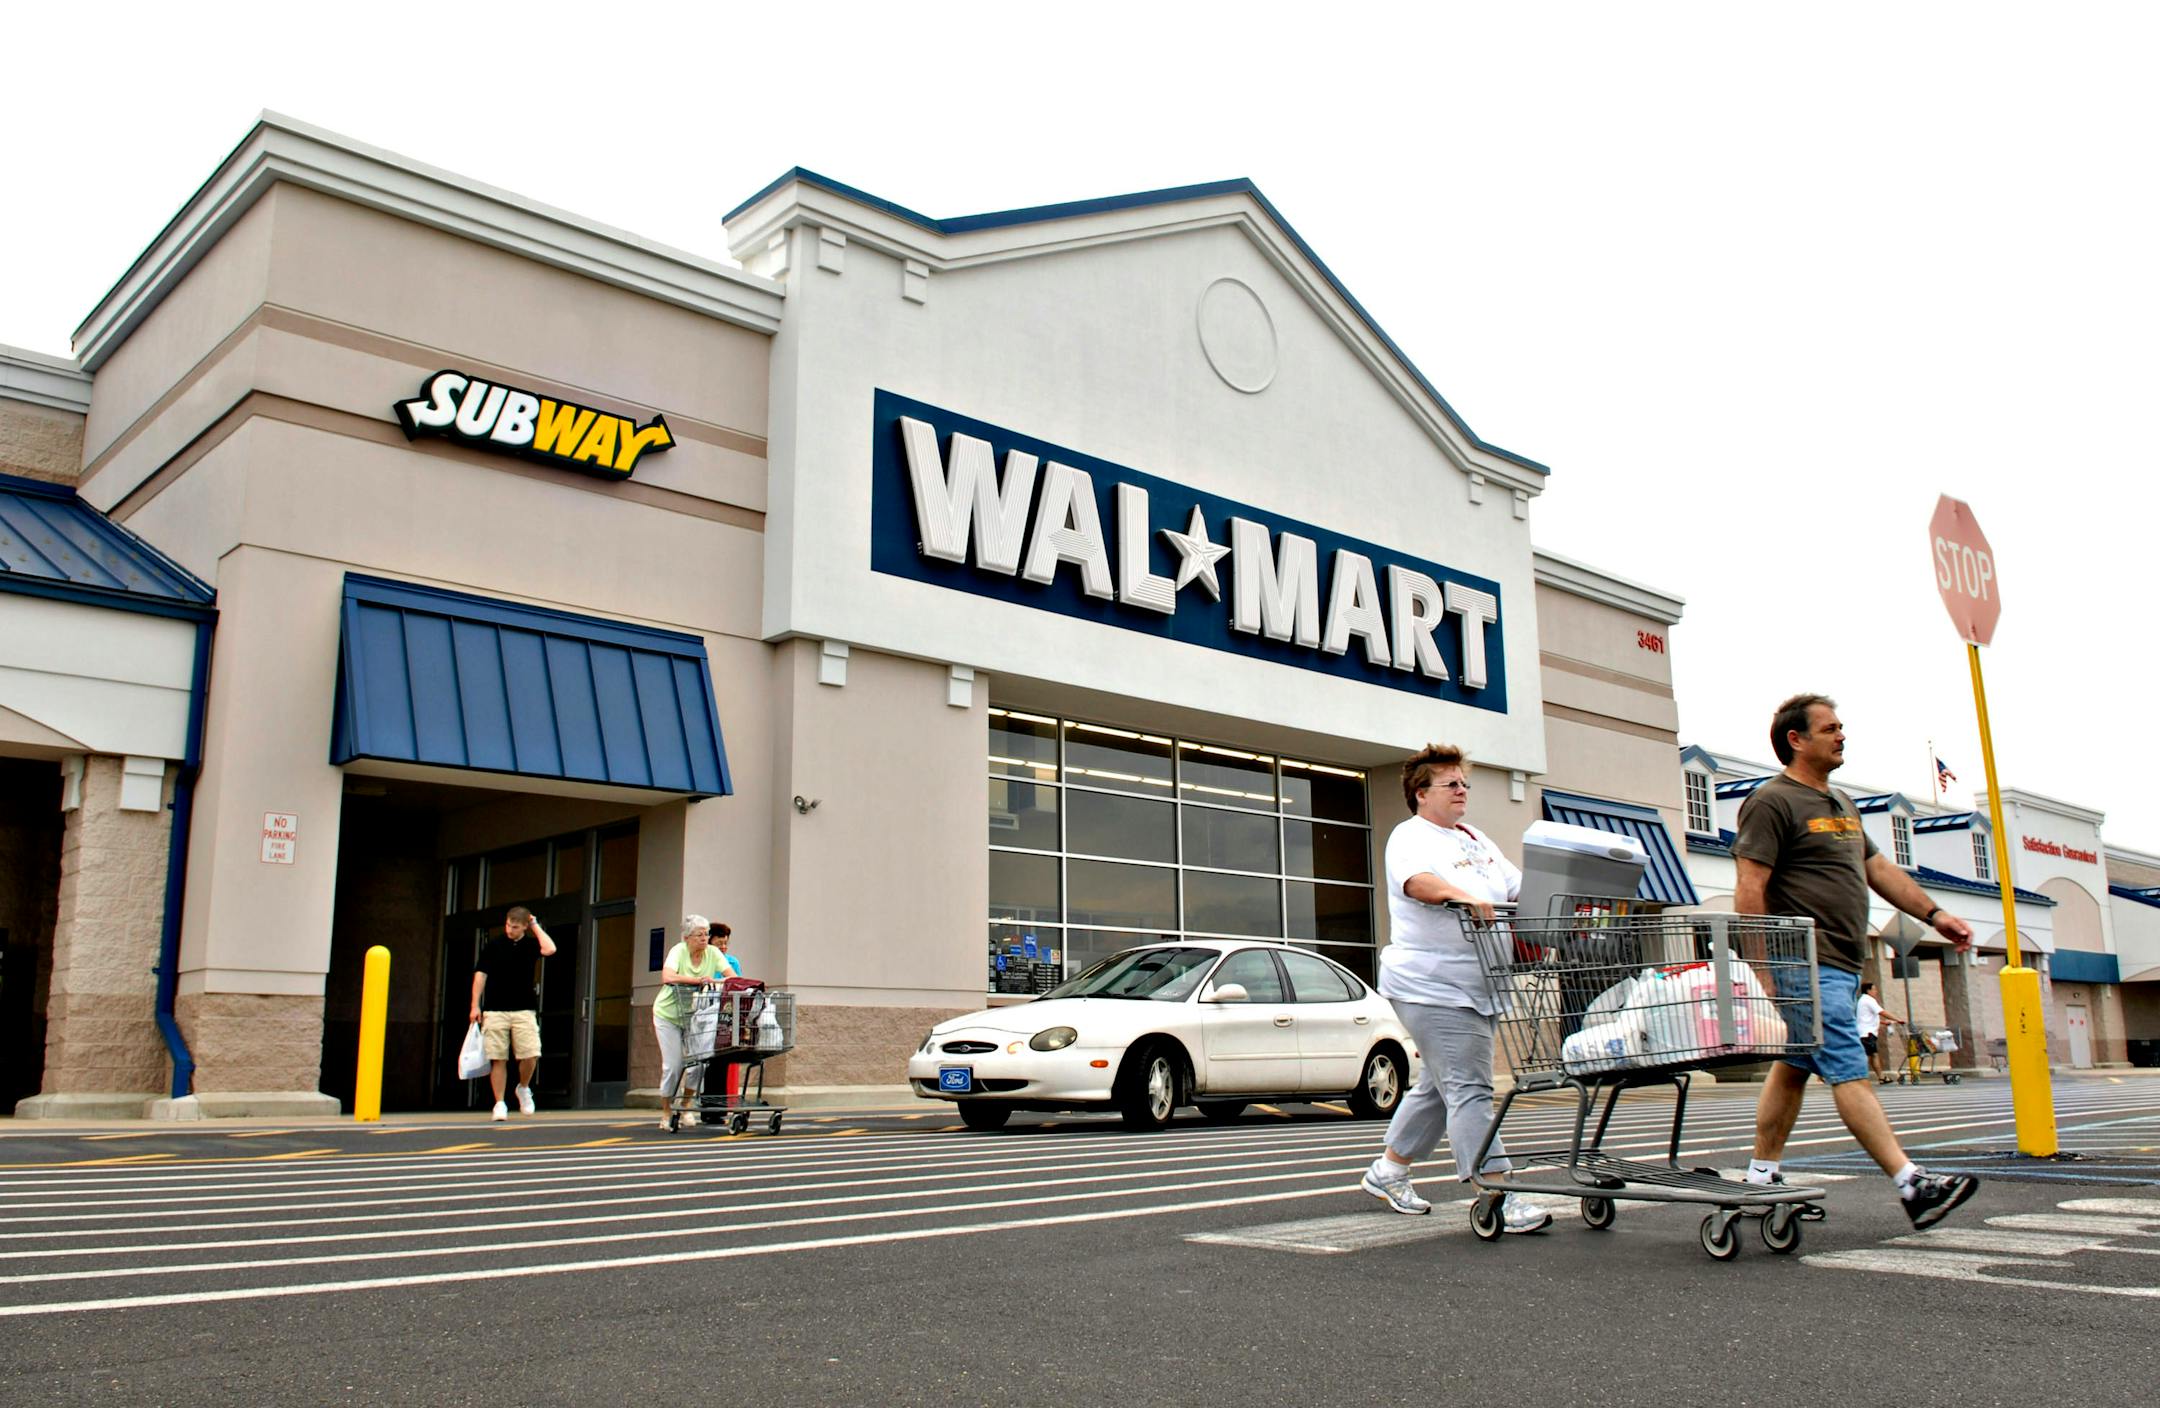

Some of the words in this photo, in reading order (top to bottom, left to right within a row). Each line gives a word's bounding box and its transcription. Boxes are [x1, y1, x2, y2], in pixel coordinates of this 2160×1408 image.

[405, 372, 672, 473] SUBWAY
[1935, 535, 1994, 601] STOP
[1637, 630, 1664, 655] 3461
[274, 817, 288, 828] NO
[263, 828, 296, 842] PARKING
[946, 1073, 964, 1085] Ford
